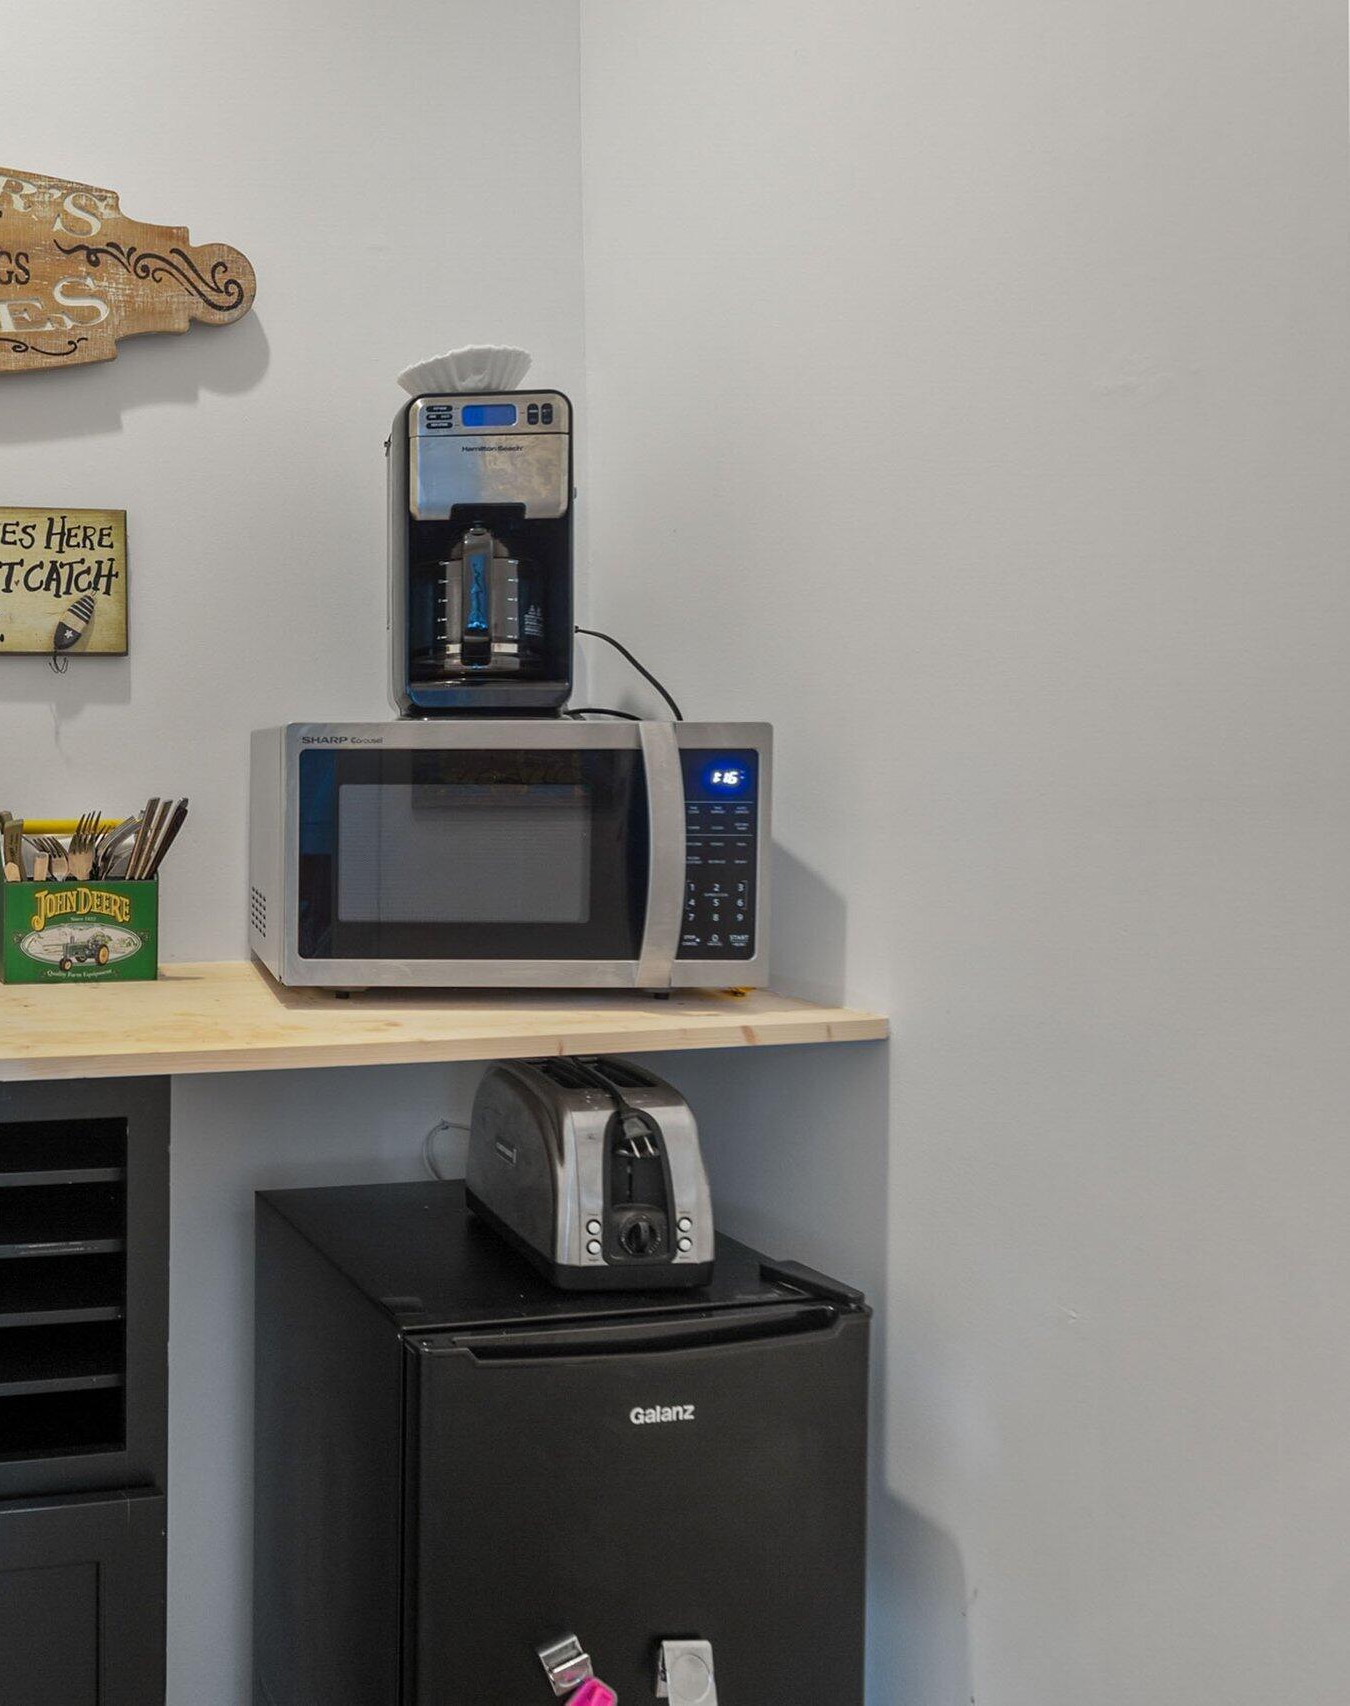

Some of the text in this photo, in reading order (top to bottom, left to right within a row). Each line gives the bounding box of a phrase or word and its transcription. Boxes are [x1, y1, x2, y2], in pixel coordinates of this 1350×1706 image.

[44, 516, 114, 553] HERE
[24, 558, 119, 598] CATCH
[301, 736, 348, 744] SHARP
[689, 883, 695, 891] 1
[713, 883, 720, 892] 2
[737, 883, 744, 892] 3
[712, 899, 720, 907] 5
[736, 899, 744, 907] 6
[31, 886, 131, 932] JOHN DEERE
[736, 913, 744, 921] 9
[630, 1404, 696, 1425] Galanz
